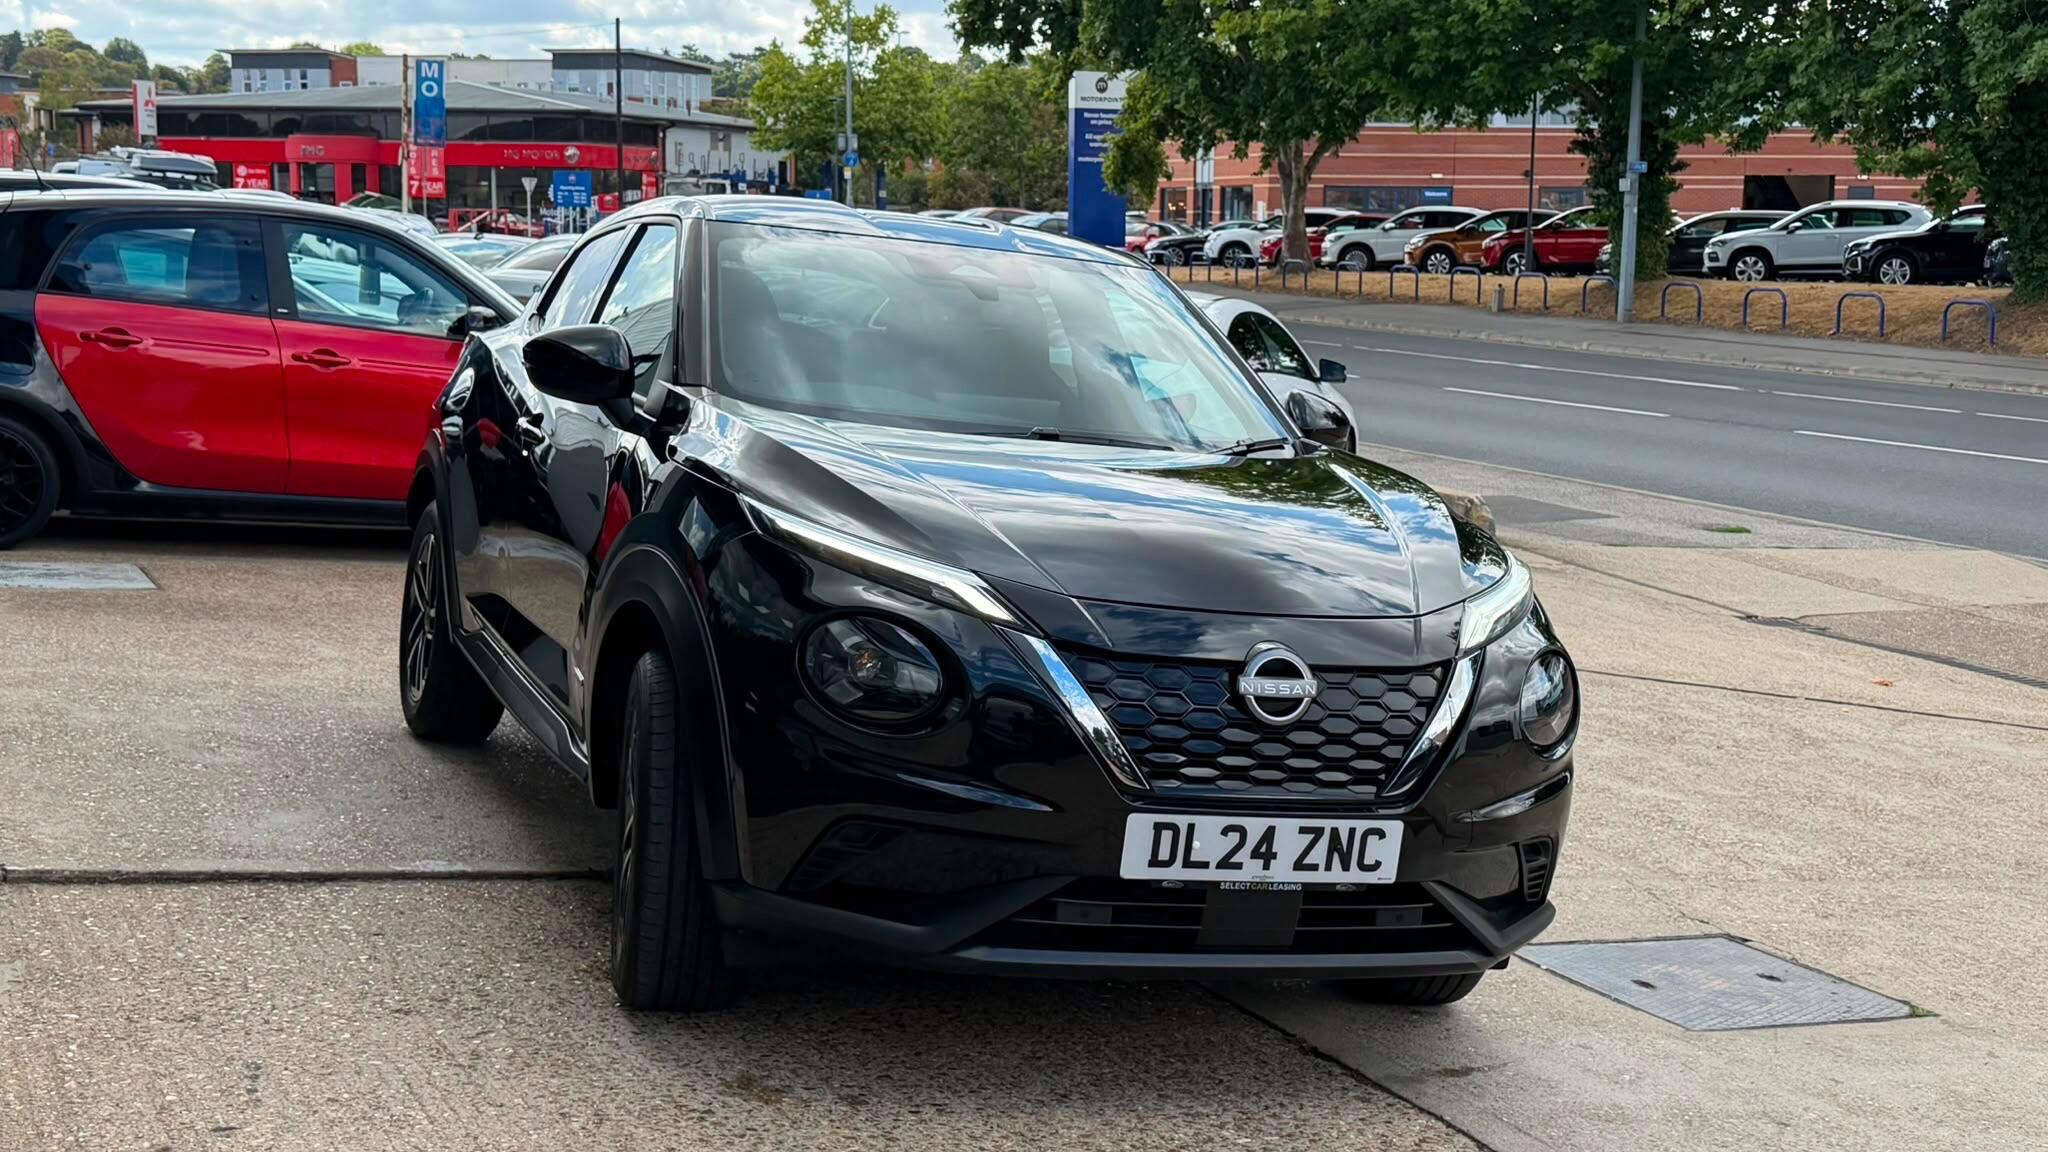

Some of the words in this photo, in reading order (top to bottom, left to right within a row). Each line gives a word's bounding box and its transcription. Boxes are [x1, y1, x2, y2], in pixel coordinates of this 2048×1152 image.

[409, 180, 419, 195] 7
[1241, 681, 1316, 695] NISSAN
[1148, 821, 1278, 870] DL24
[1292, 826, 1387, 872] ZNC
